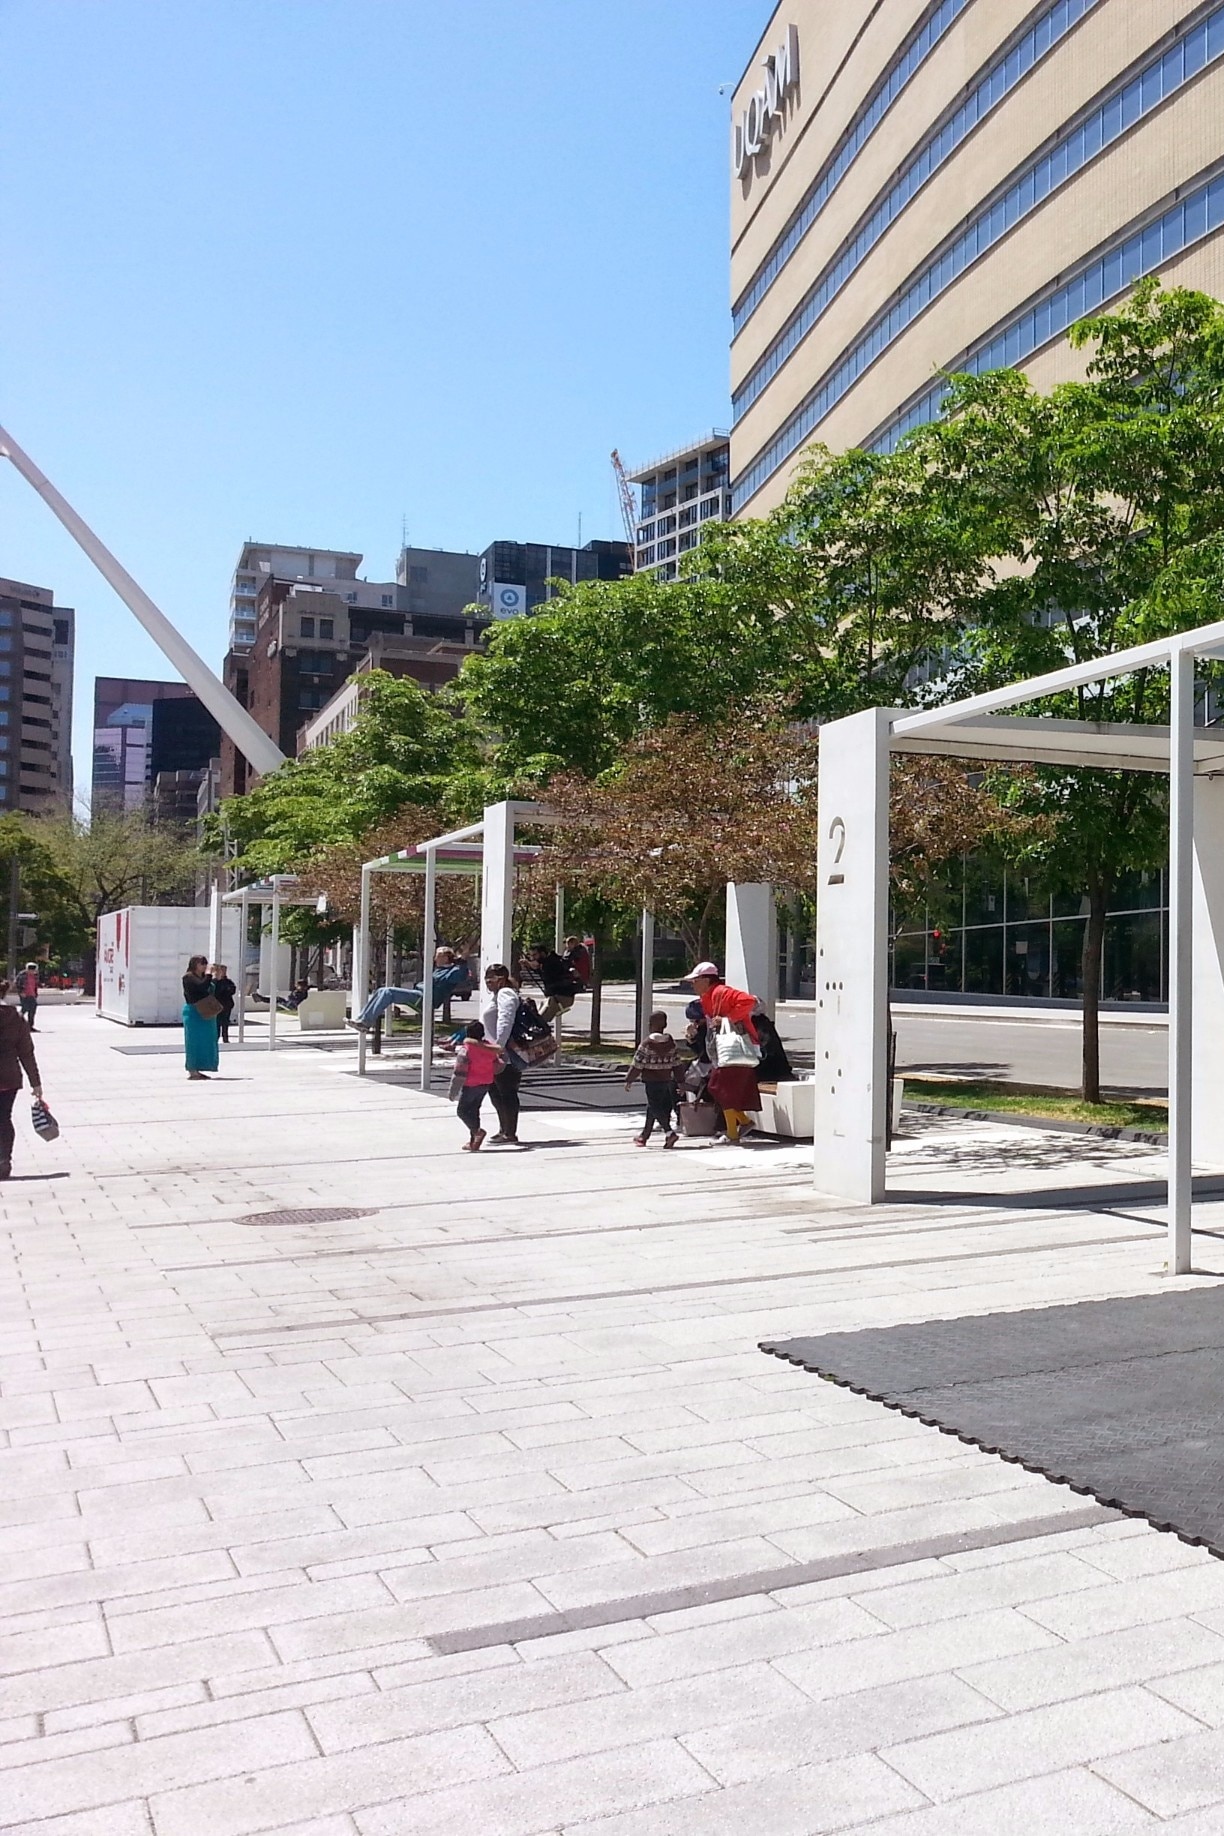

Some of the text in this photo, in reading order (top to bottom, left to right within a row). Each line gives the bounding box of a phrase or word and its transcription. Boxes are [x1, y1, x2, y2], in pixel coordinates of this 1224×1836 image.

[733, 23, 800, 180] UQAM
[500, 608, 519, 616] evo
[827, 815, 846, 886] 2
